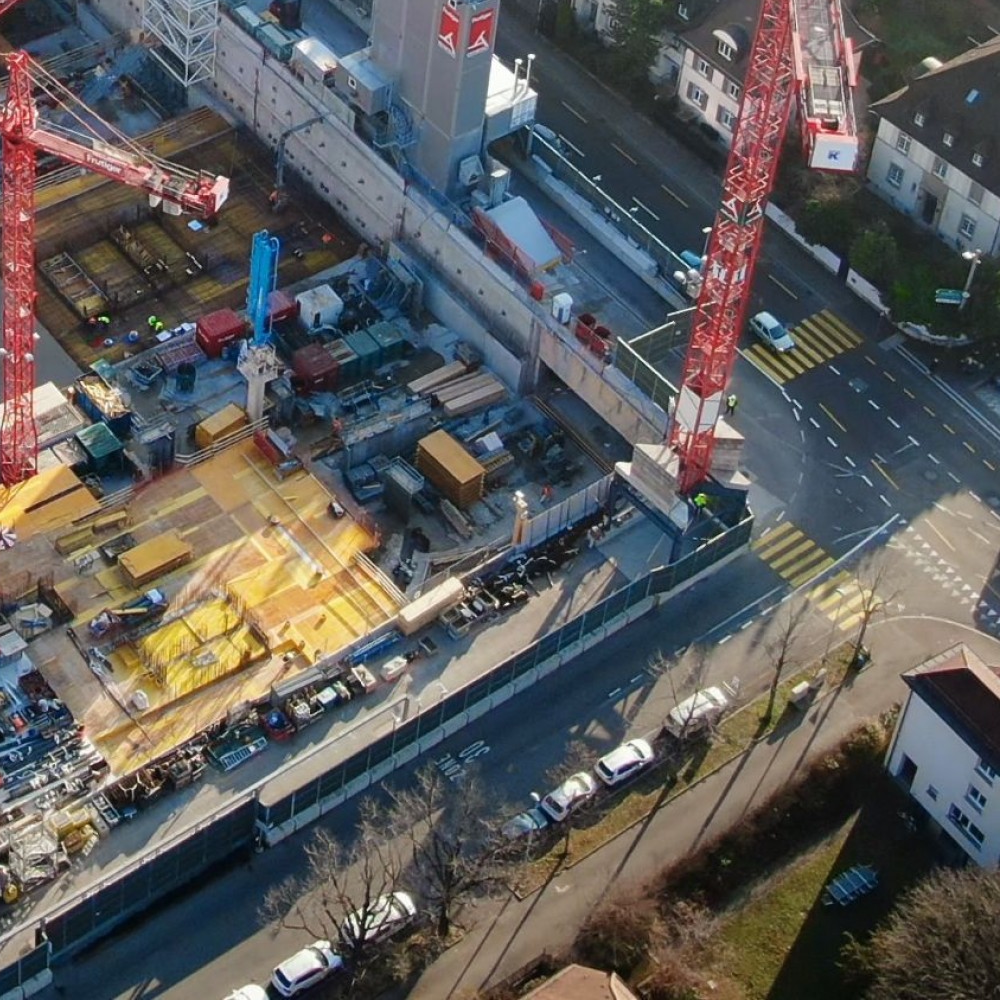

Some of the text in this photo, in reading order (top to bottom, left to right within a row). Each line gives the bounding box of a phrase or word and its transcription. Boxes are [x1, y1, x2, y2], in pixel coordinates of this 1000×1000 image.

[86, 151, 122, 174] Frutiger
[827, 149, 841, 161] K
[458, 741, 491, 766] 30
